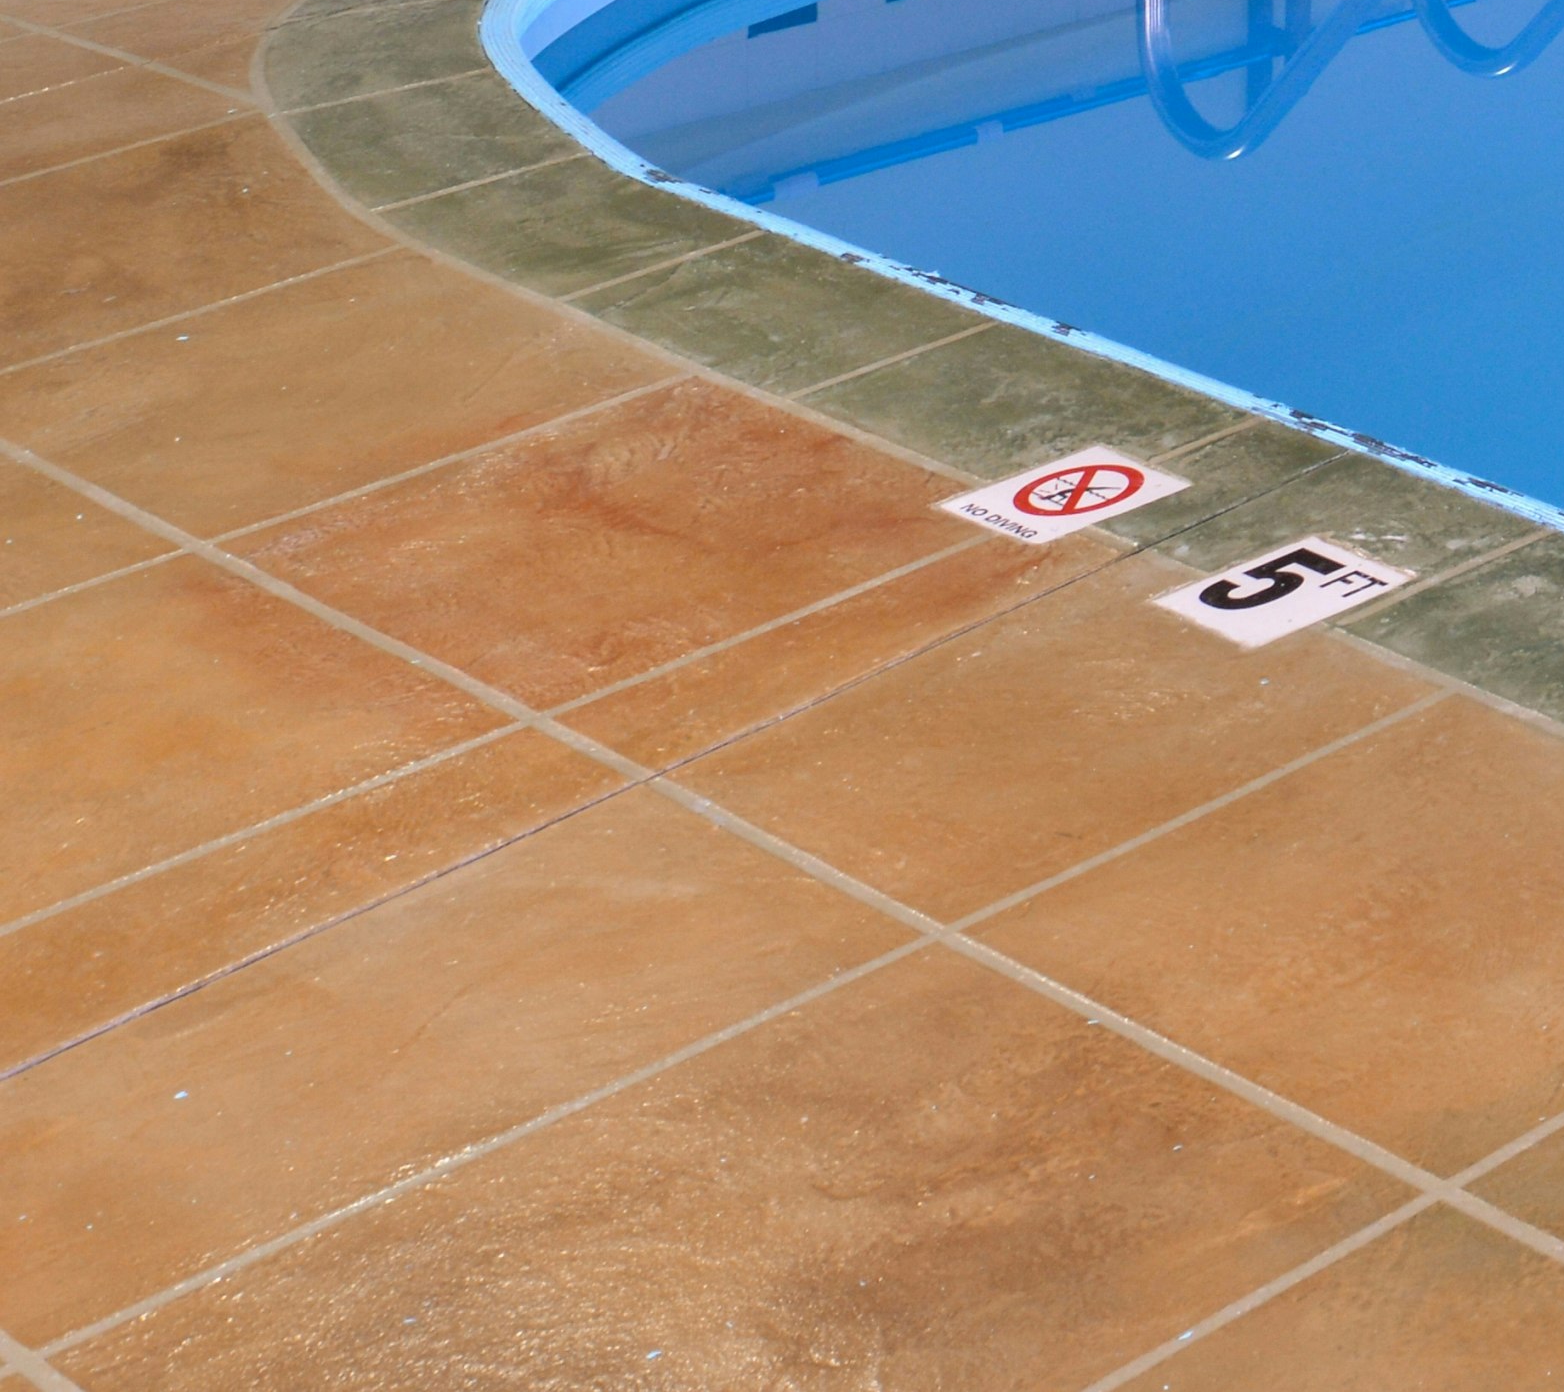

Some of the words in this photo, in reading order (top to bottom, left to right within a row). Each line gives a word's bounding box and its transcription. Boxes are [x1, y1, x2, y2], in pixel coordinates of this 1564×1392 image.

[960, 503, 988, 516] NO
[985, 514, 1037, 538] DIVING
[1199, 547, 1347, 610] 5
[1320, 570, 1389, 598] FT
